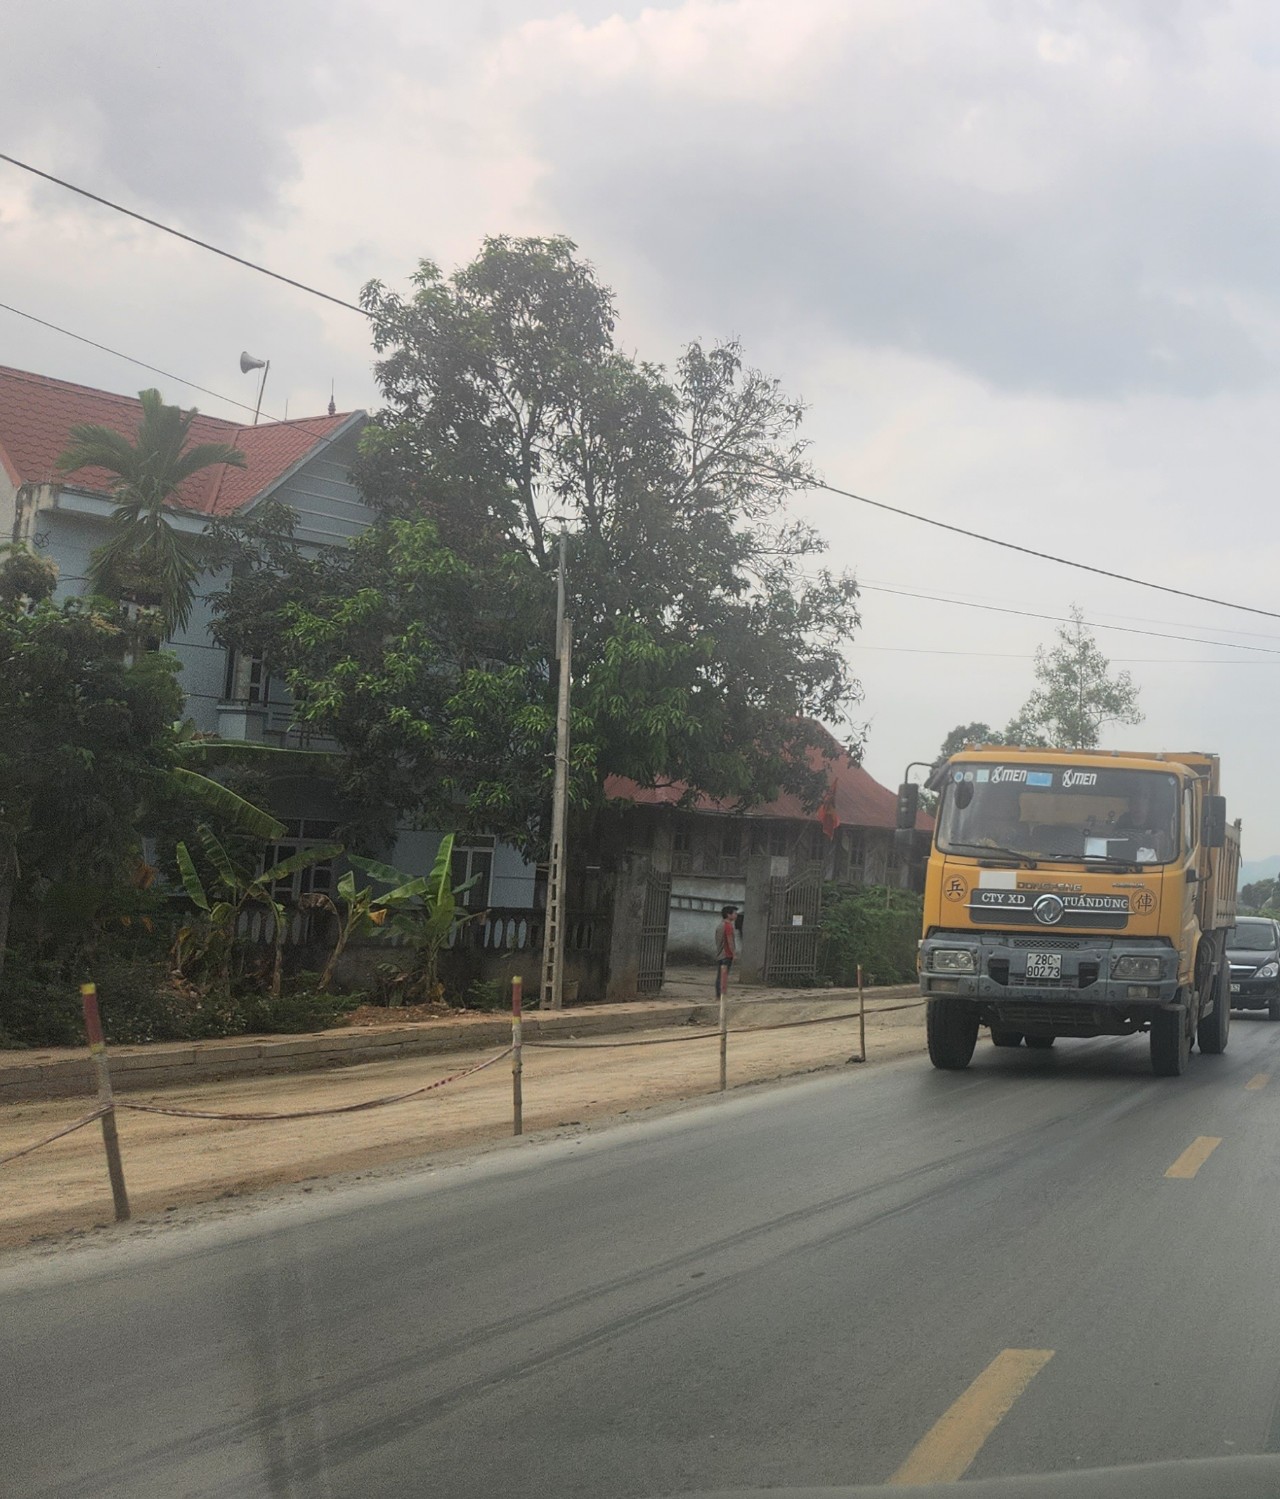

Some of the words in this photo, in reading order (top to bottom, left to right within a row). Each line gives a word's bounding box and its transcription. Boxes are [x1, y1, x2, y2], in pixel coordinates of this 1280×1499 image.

[981, 892, 1005, 903] CTY
[1008, 894, 1026, 904] XD
[1035, 954, 1054, 966] 28C
